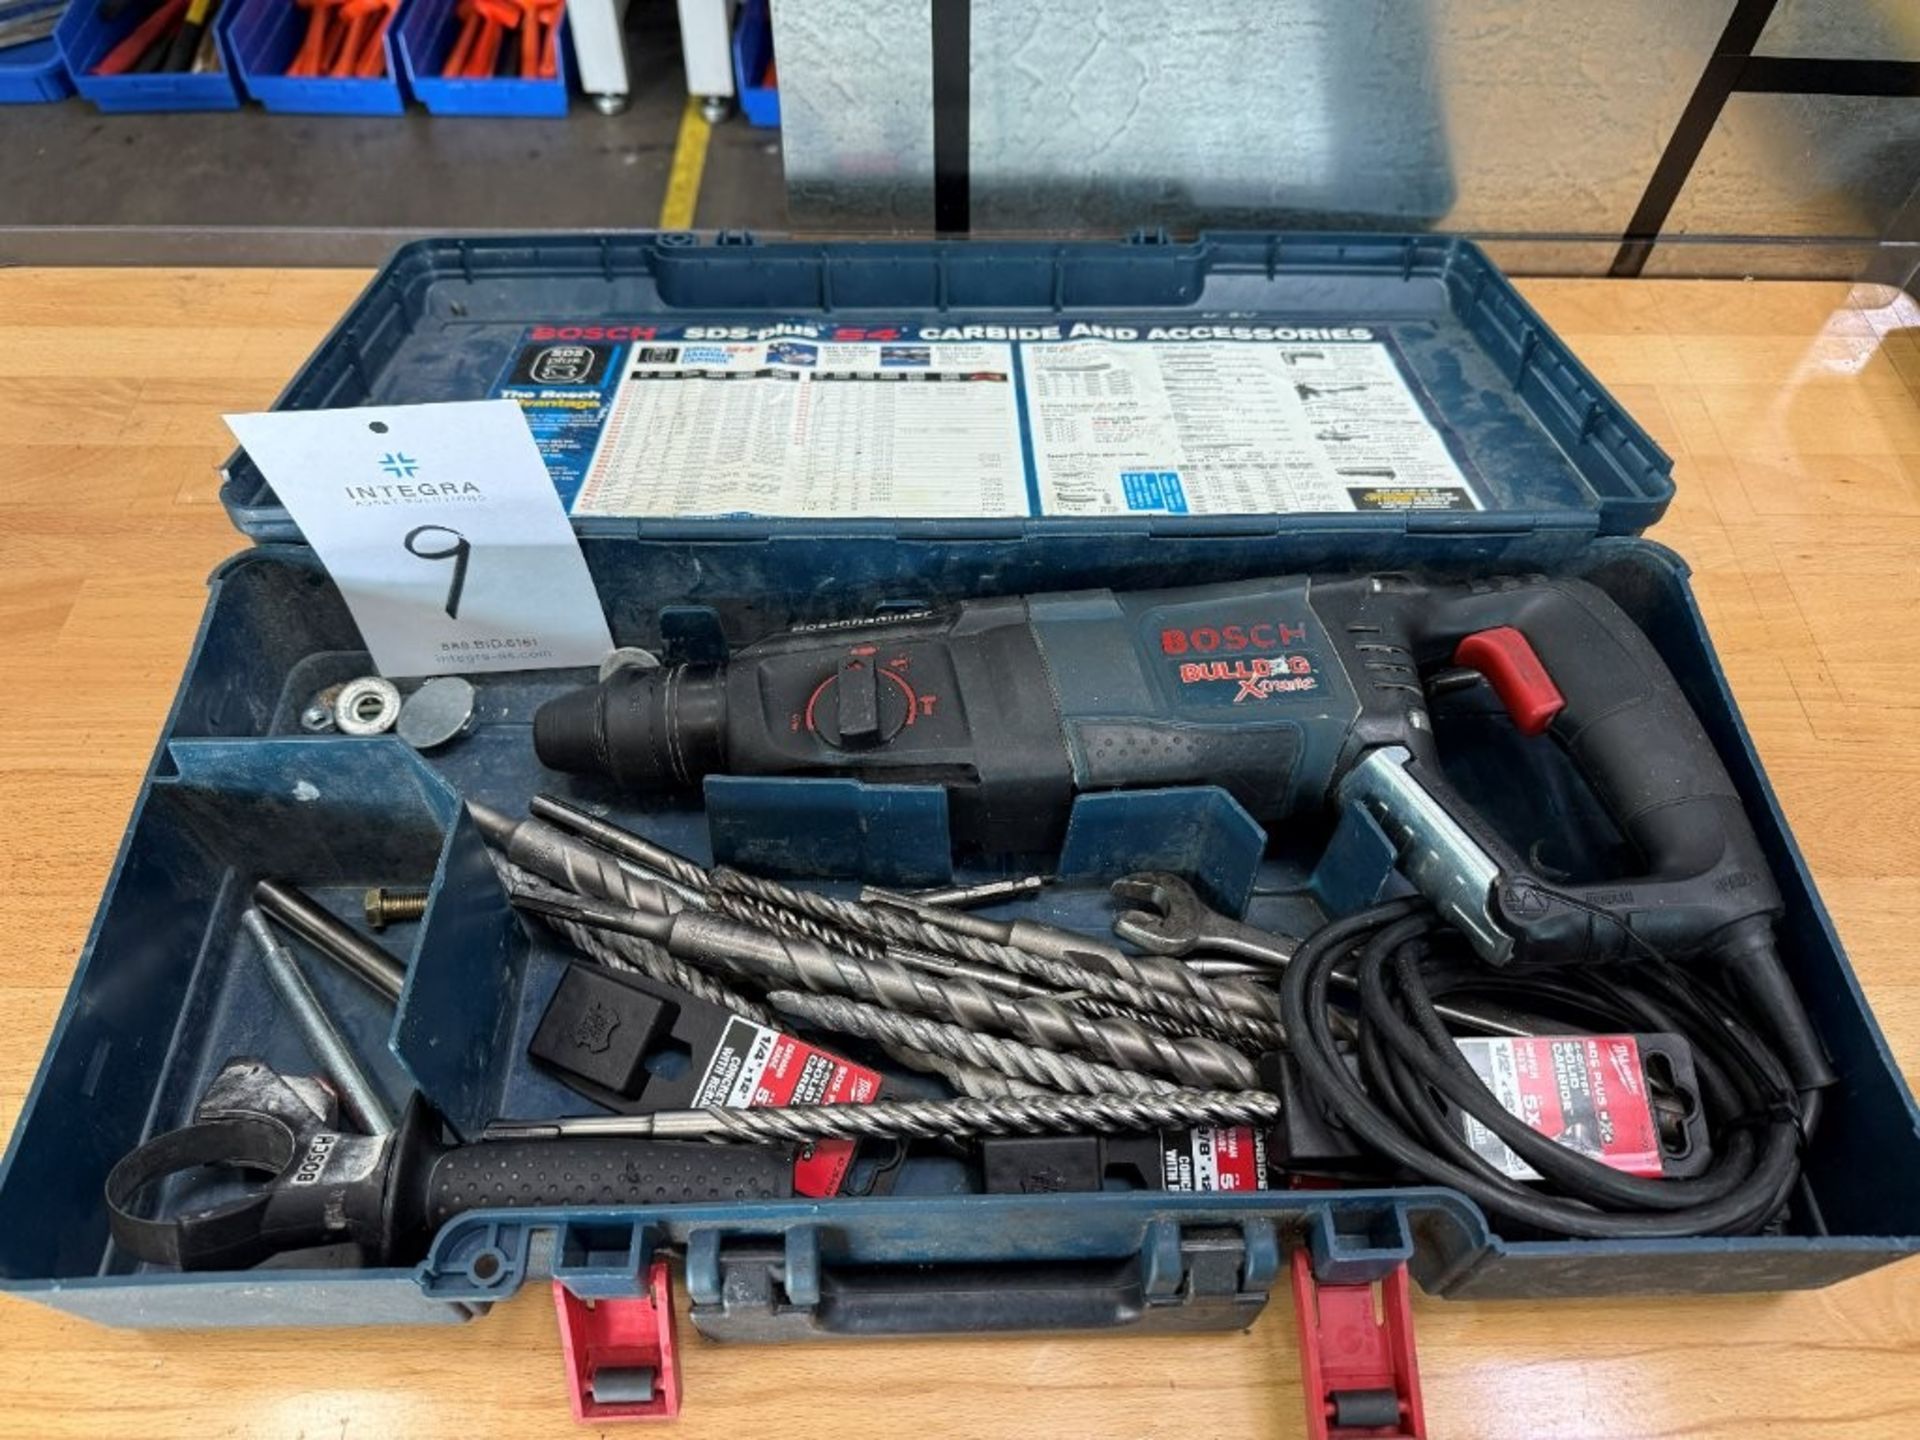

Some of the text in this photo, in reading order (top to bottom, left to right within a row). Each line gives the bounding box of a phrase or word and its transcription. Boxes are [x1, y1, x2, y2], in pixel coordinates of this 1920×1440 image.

[531, 327, 658, 341] BOSCH
[832, 328, 900, 341] S4
[919, 326, 1061, 341] CARBIDE
[1070, 323, 1138, 340] AND
[1148, 326, 1373, 341] ACCESSORIES
[501, 390, 535, 398] The
[345, 481, 482, 500] INTEGRA
[404, 525, 471, 619] 9
[1161, 621, 1307, 656] BOSCH
[700, 1047, 735, 1106] WITH REBA
[1564, 1042, 1580, 1089] SOLID
[1593, 1071, 1609, 1104] PLUS
[296, 1135, 336, 1182] BOSCH
[1165, 1149, 1179, 1181] WITH
